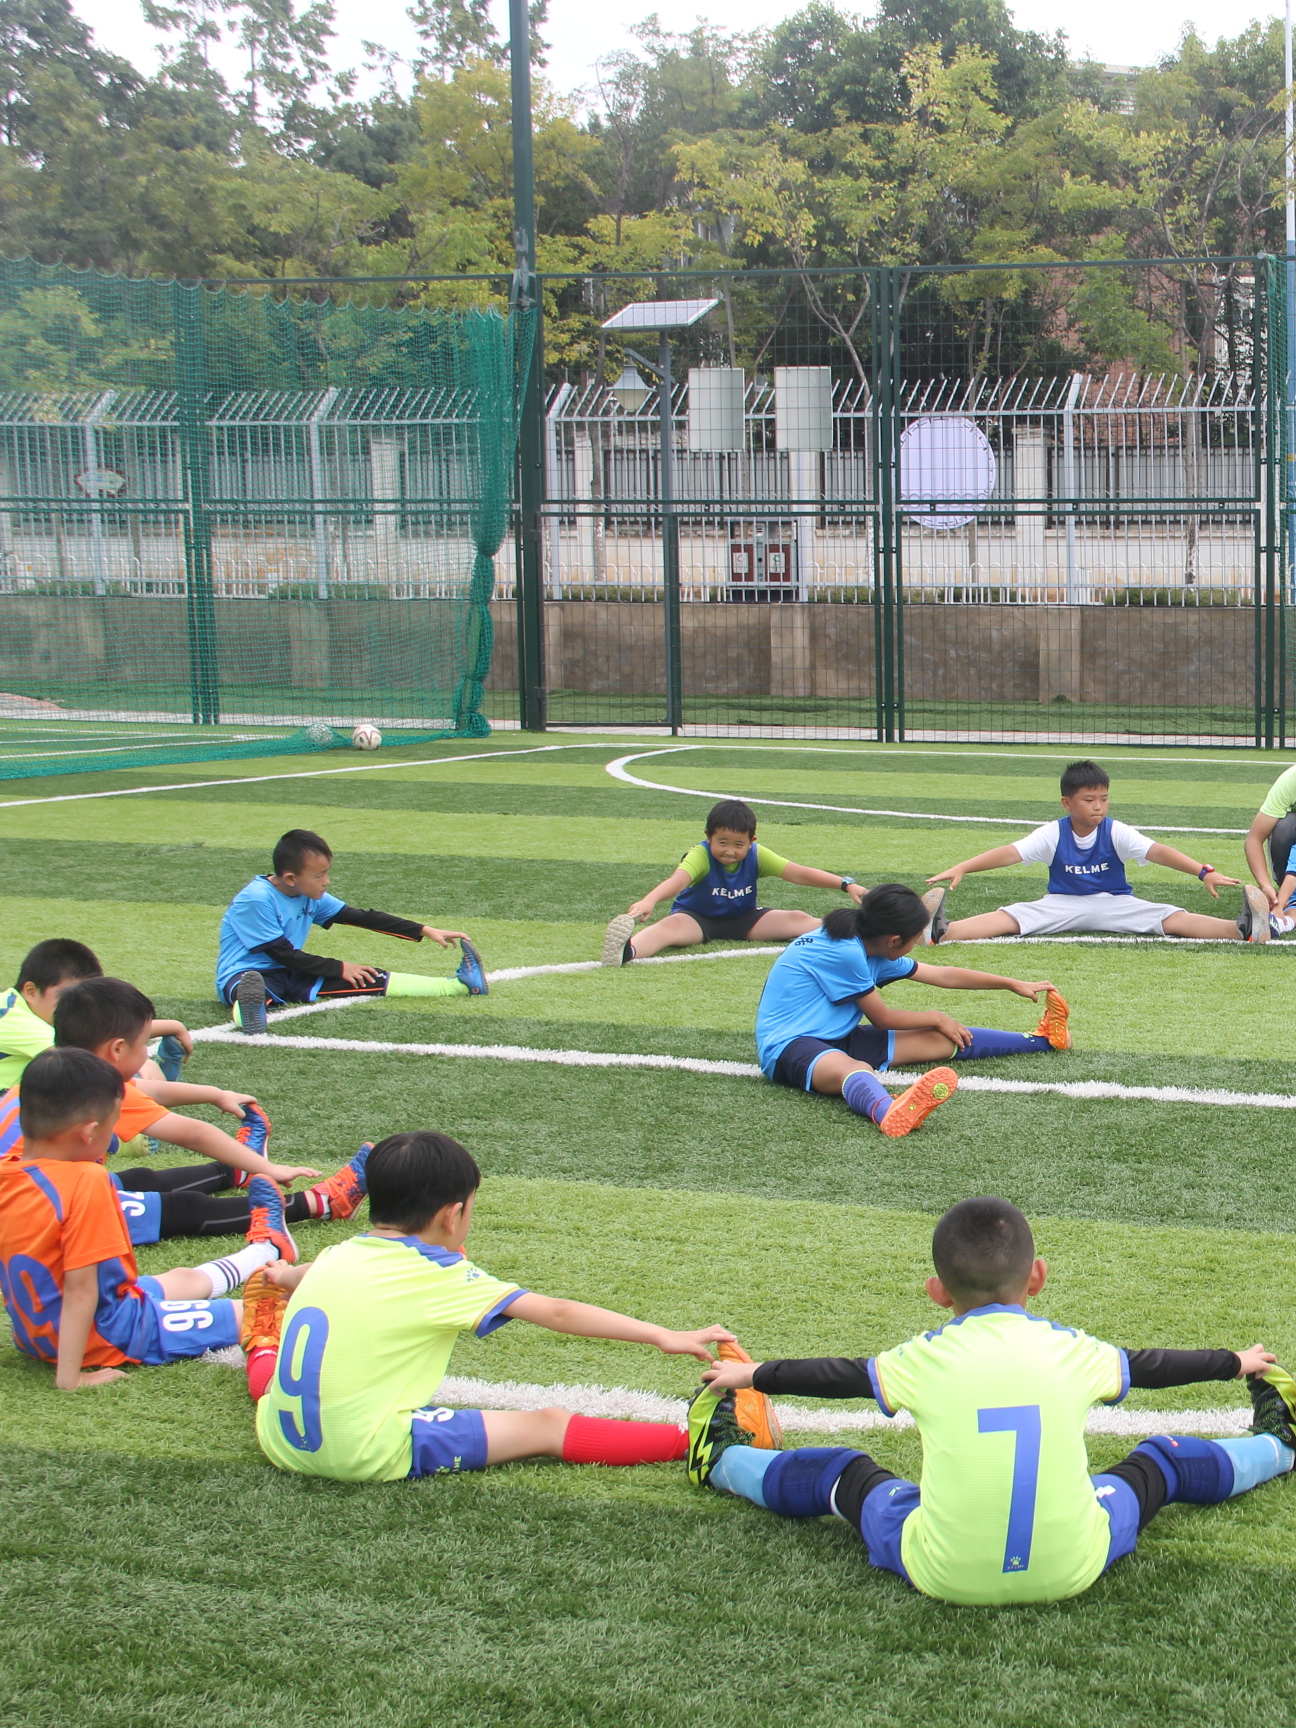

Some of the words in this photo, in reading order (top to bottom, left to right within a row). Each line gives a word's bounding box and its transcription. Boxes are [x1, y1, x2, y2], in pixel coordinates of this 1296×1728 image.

[711, 885, 753, 899] KELME
[1065, 862, 1109, 875] KELME
[278, 1306, 330, 1453] 9
[976, 1404, 1042, 1574] 7
